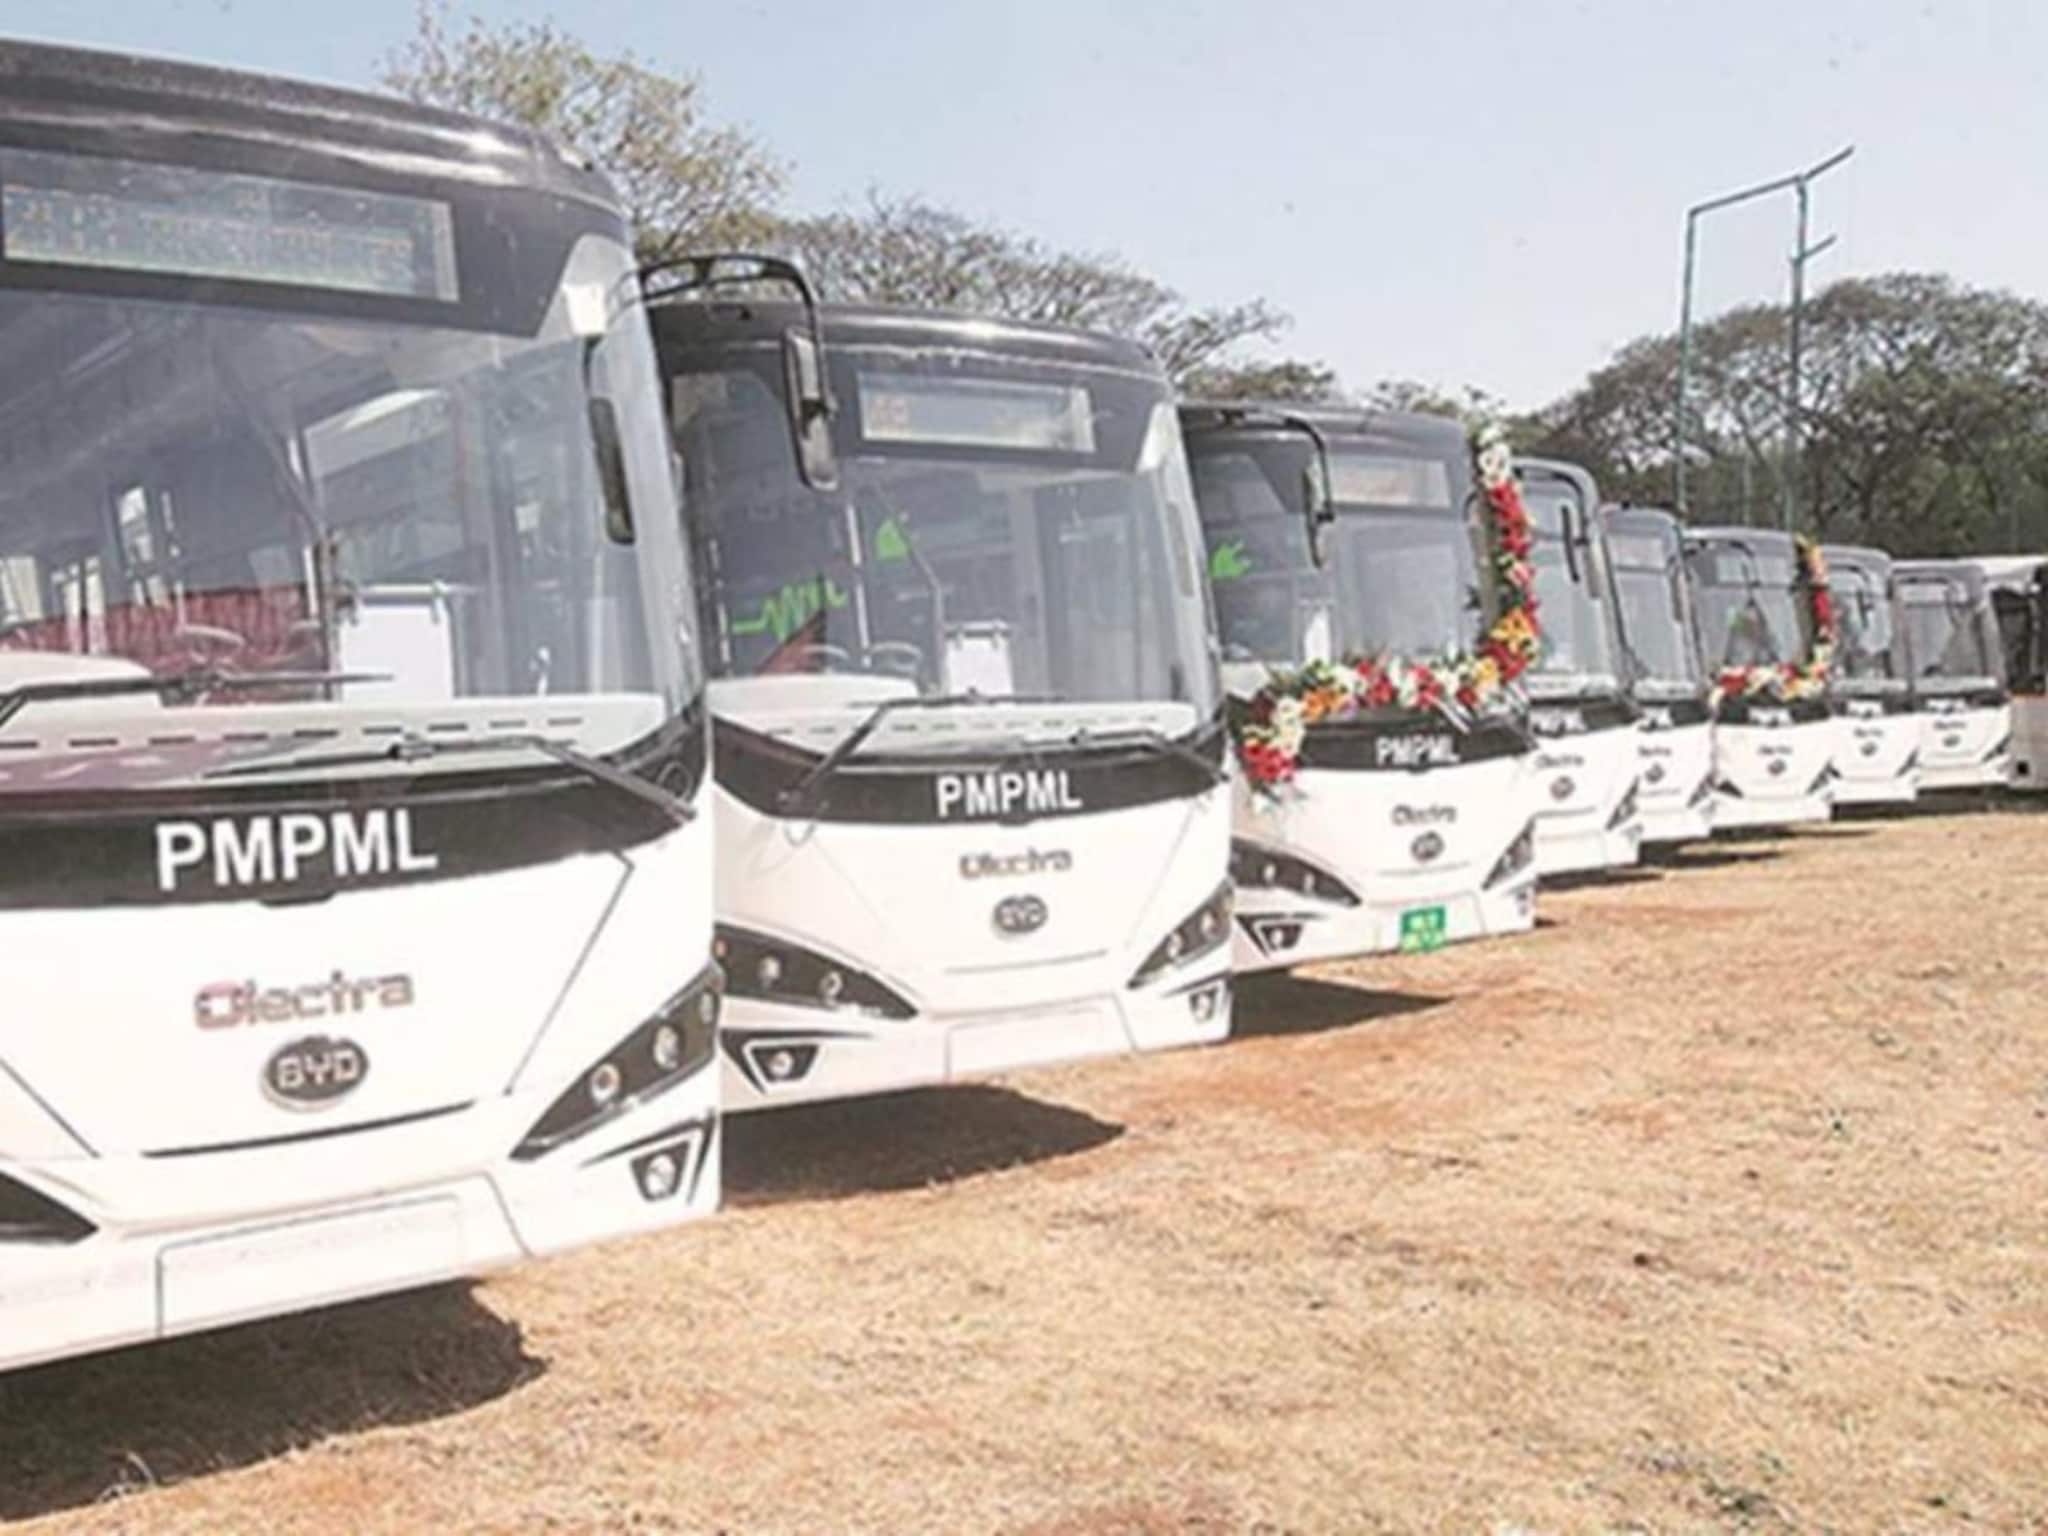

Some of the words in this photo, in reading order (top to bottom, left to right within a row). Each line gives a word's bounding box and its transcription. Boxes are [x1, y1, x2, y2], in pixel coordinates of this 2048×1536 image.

[1375, 734, 1461, 768] PMPML
[935, 769, 1083, 818] PMPML
[155, 806, 438, 891] PMPML
[275, 1048, 362, 1090] BYD
